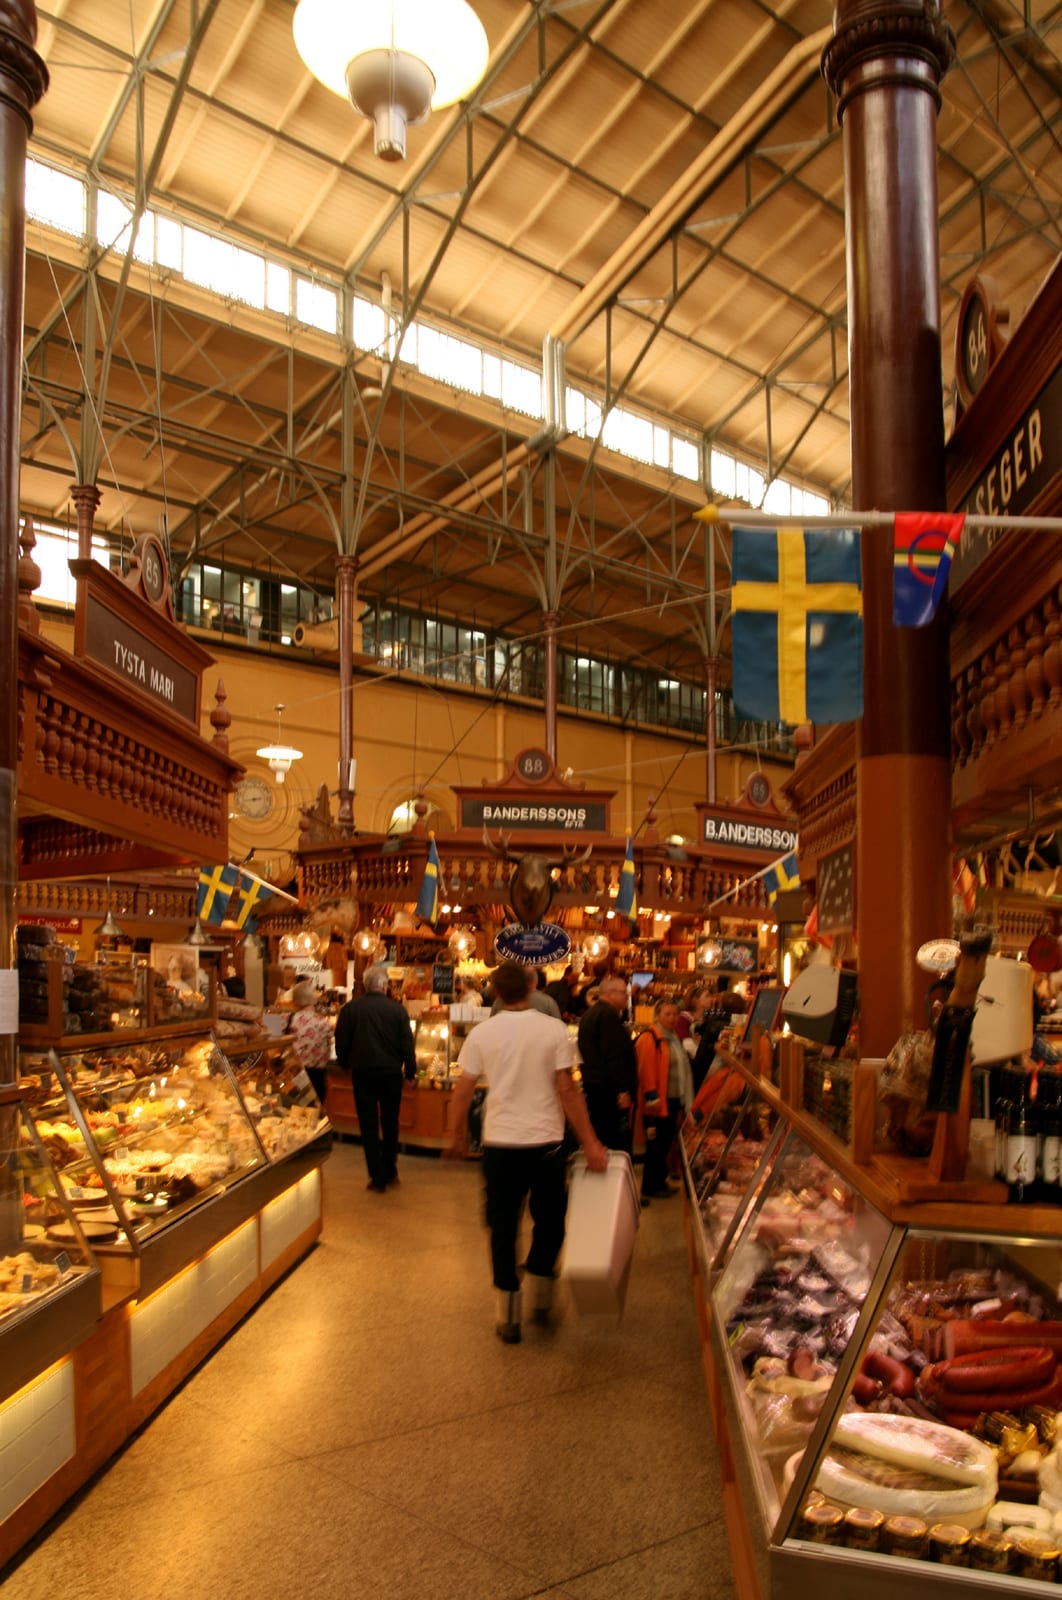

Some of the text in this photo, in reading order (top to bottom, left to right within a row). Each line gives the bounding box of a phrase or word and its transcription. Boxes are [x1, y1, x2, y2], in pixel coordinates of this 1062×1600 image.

[968, 311, 987, 376] 84
[975, 408, 1044, 537] SEGER
[145, 557, 159, 589] 85
[114, 640, 175, 702] TYSTA MARI
[524, 757, 543, 773] 88
